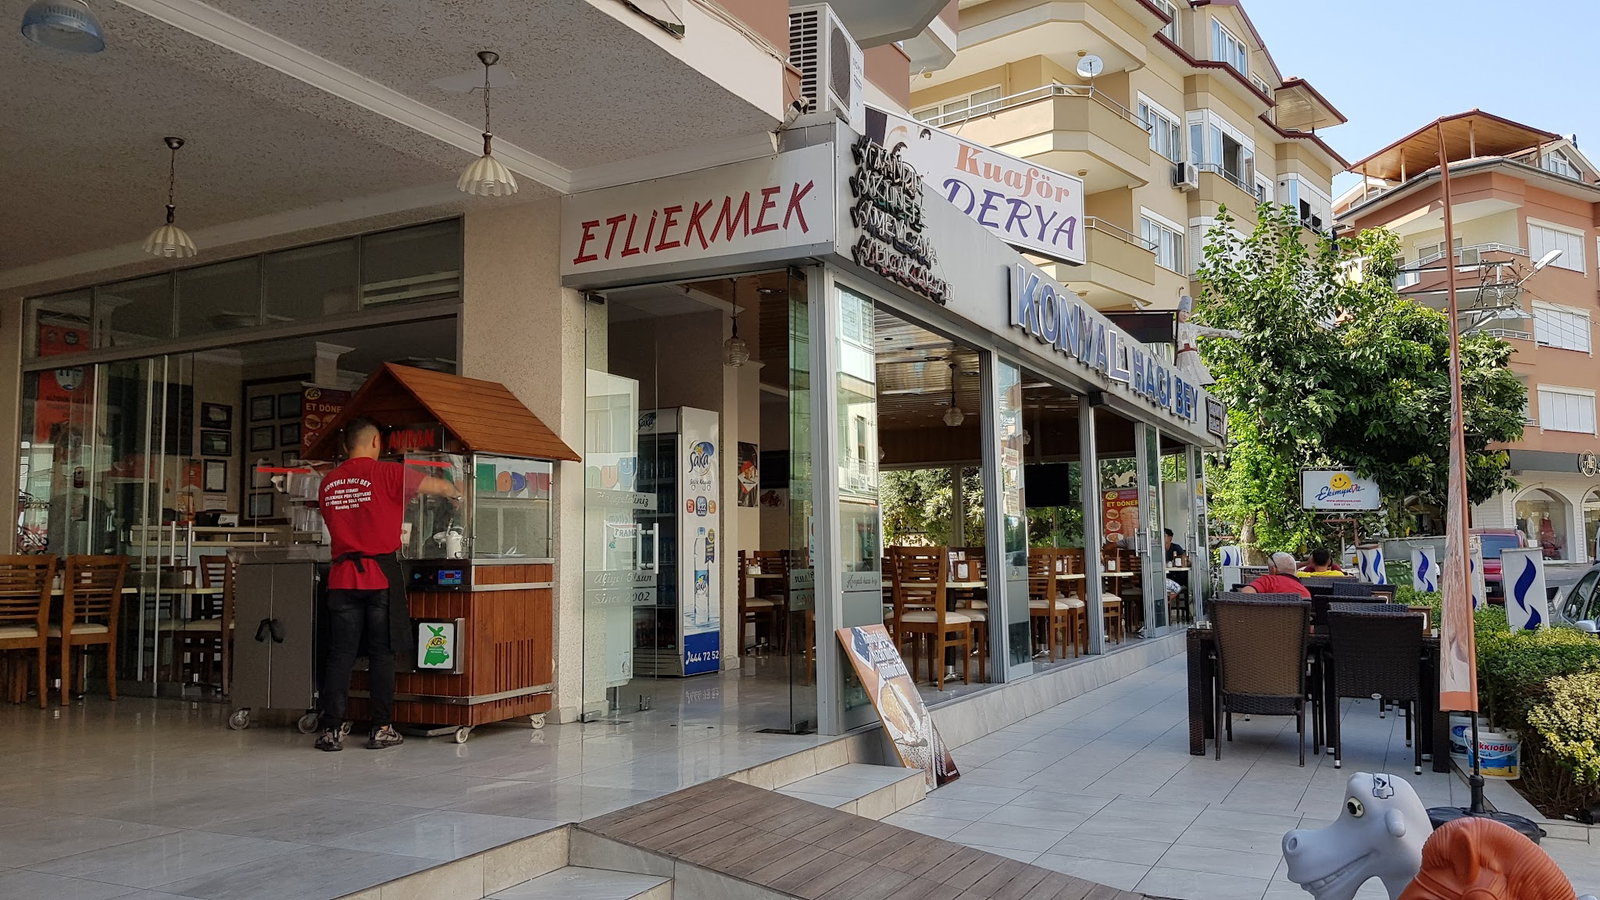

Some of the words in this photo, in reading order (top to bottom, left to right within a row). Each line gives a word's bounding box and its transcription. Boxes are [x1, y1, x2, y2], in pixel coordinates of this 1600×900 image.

[954, 143, 1070, 204] Kuaför
[942, 178, 1077, 251] DERYA
[1131, 345, 1172, 410] HACI
[1175, 376, 1199, 422] BEY
[305, 402, 317, 411] ET
[319, 403, 343, 413] DÖNE
[360, 479, 371, 487] BEY
[689, 652, 702, 664] 444
[702, 651, 711, 662] 72
[711, 649, 720, 660] 52
